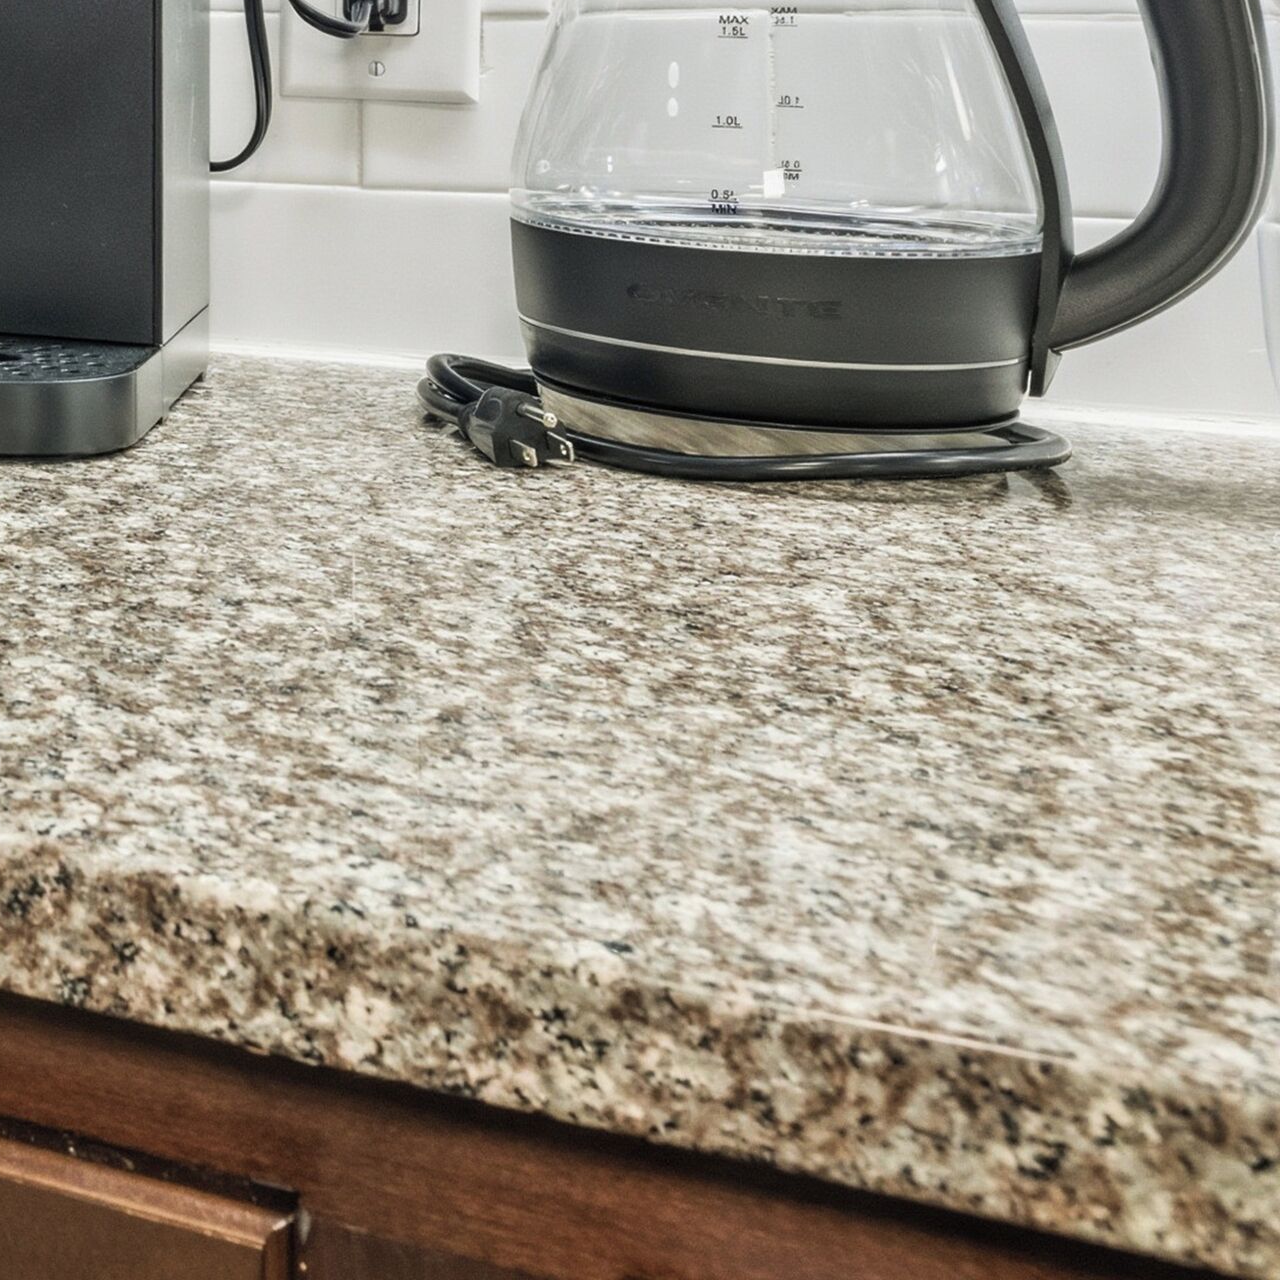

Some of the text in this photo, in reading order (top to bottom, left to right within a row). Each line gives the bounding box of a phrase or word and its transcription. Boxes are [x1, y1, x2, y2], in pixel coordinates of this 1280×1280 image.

[718, 15, 749, 25] MAX
[721, 26, 746, 36] 1.5L
[716, 116, 741, 126] 1.0L
